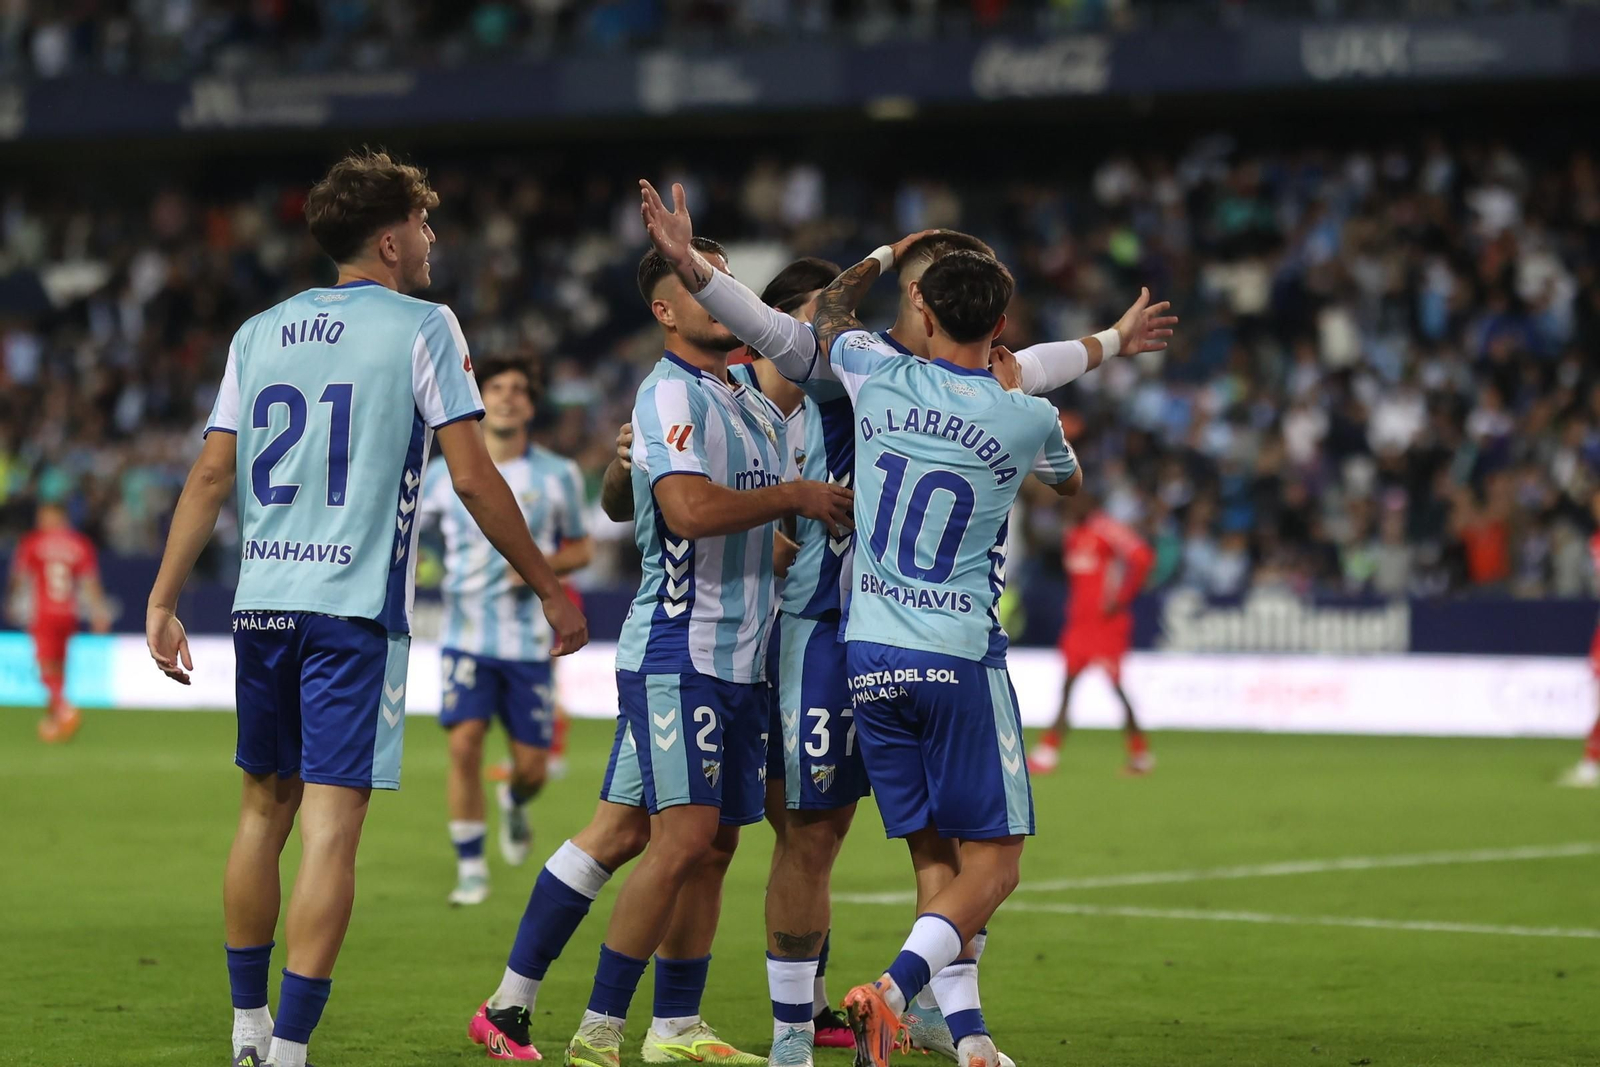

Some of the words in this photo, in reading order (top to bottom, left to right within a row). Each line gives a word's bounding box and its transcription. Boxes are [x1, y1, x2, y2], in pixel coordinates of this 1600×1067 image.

[281, 312, 346, 348] NIÑO
[252, 382, 354, 507] 21
[860, 416, 882, 442] D.
[885, 407, 1019, 486] LARRUBIA
[869, 450, 976, 585] 10
[241, 539, 353, 566] ENAHAVIS
[860, 572, 973, 614] BENAHAVIS
[240, 614, 296, 631] MÁLAGA
[853, 670, 892, 689] COSTA
[894, 668, 923, 683] DEL
[925, 668, 960, 685] SOL
[857, 685, 909, 704] MÁLAGA
[693, 705, 718, 753] 2
[804, 707, 857, 757] 37
